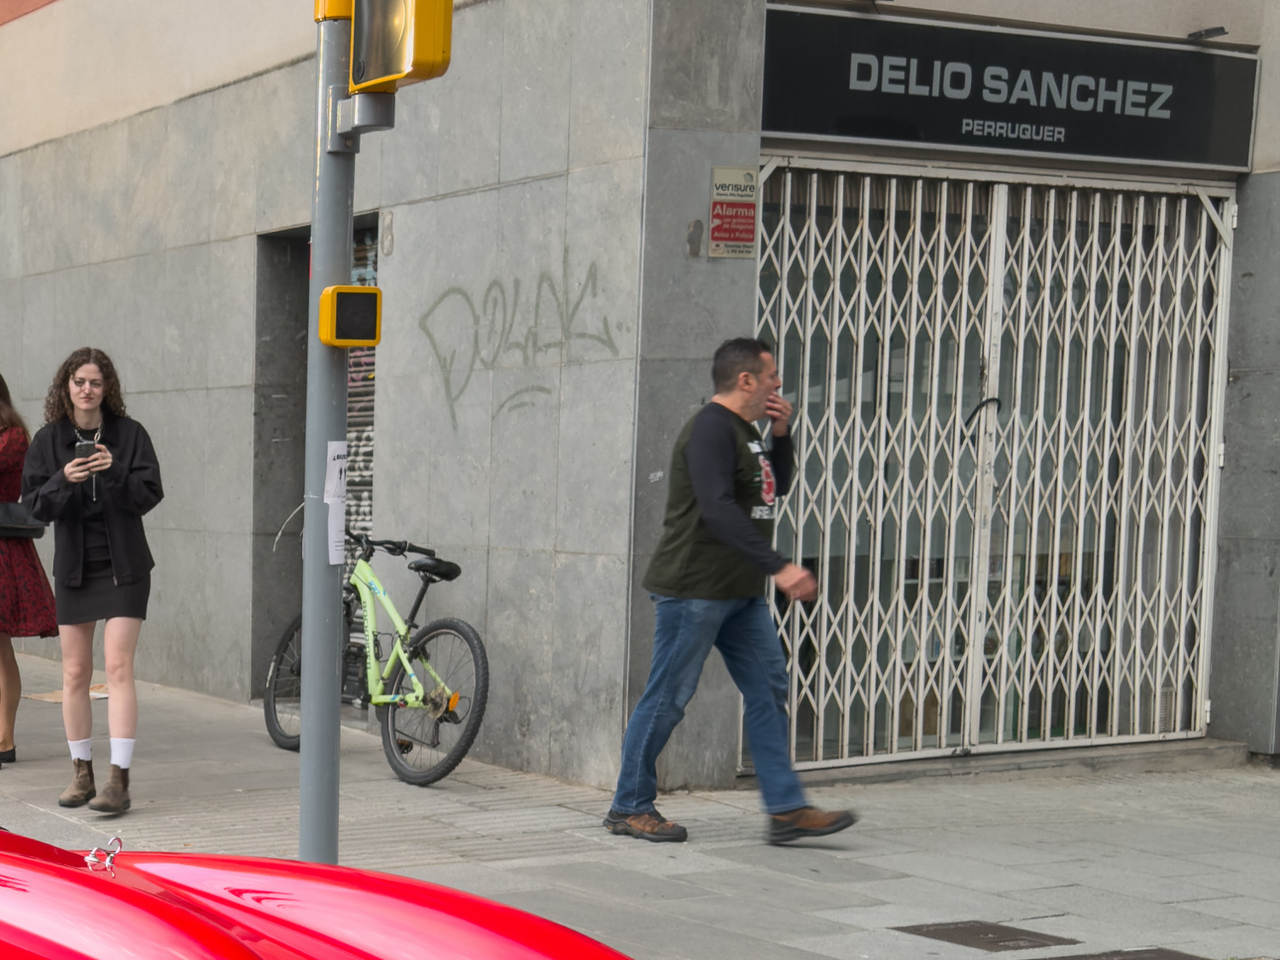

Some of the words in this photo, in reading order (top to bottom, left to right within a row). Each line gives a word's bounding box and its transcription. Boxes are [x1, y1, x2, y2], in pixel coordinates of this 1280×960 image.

[848, 52, 973, 100] DELIO
[982, 65, 1174, 120] SANCHEZ
[961, 118, 1066, 143] PERRUQUER
[714, 183, 756, 193] verisure
[713, 204, 754, 217] Alarma
